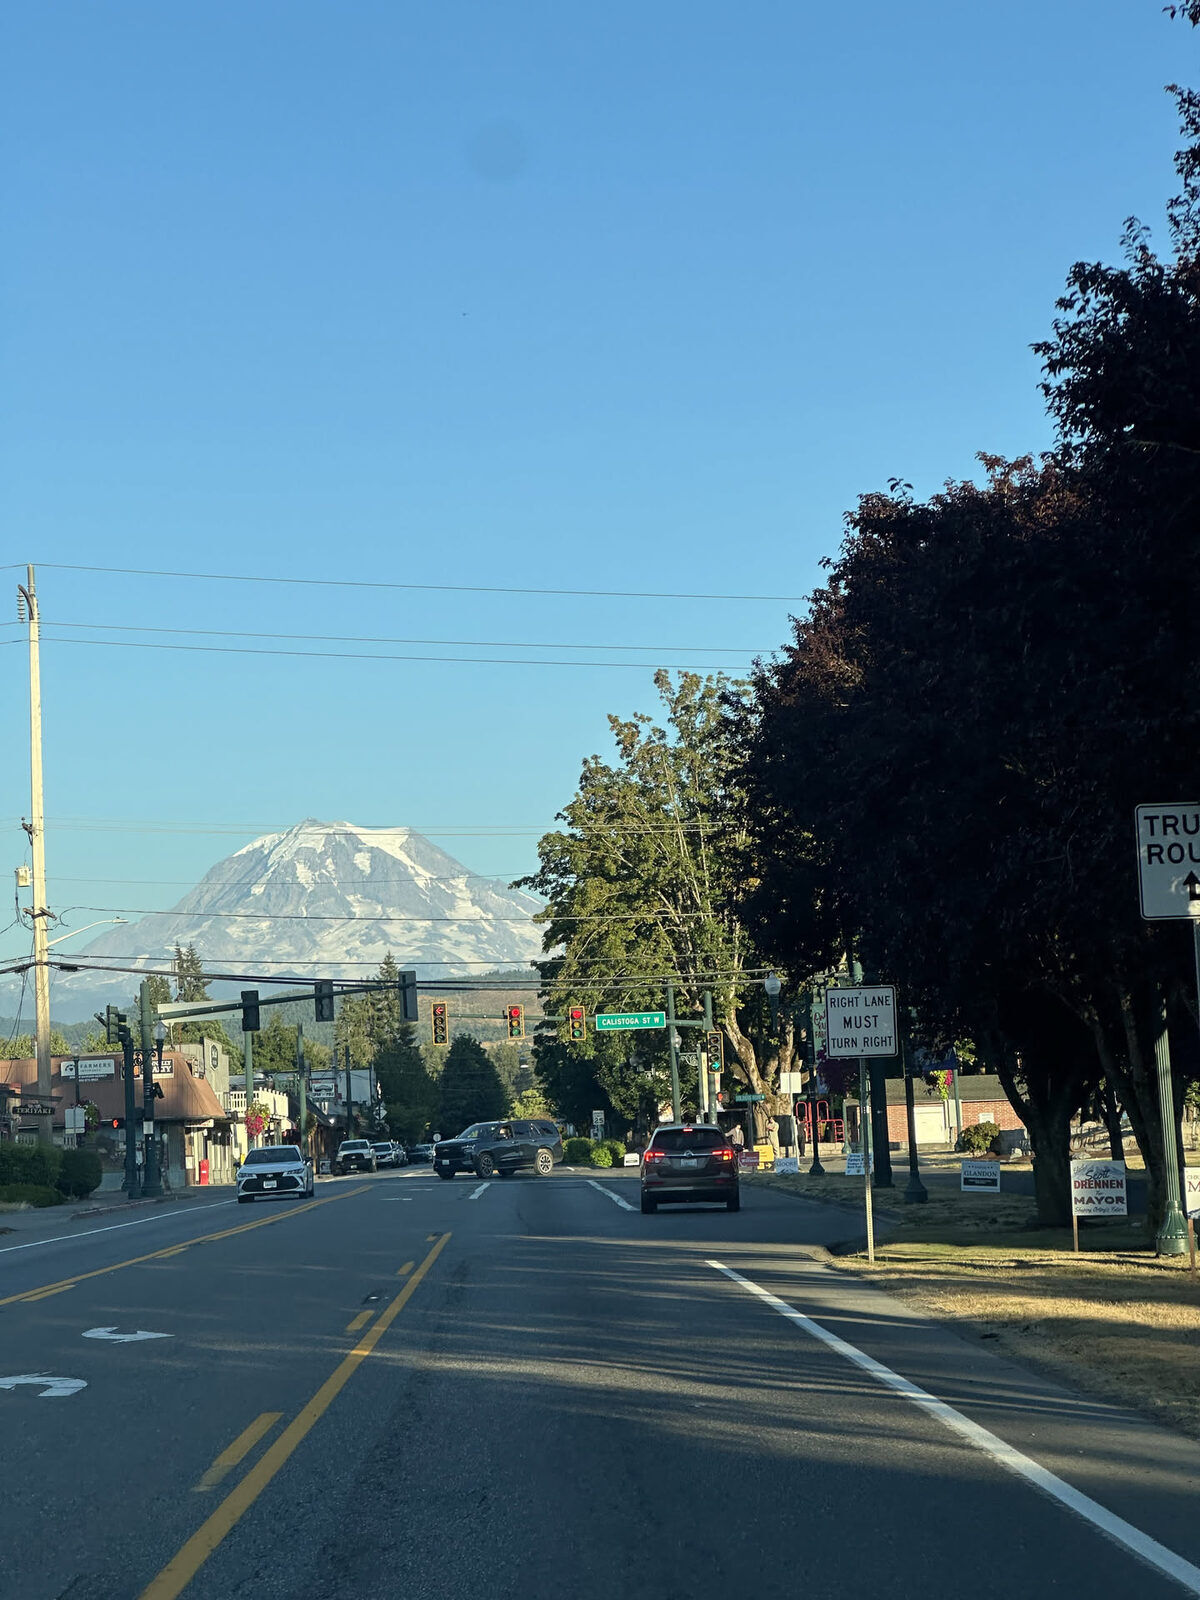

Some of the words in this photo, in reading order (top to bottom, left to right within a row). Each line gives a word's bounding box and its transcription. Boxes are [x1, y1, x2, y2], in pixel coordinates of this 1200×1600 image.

[830, 997, 860, 1008] RIGHT
[865, 996, 891, 1007] LANE
[602, 1018, 639, 1026] CALISTOGA
[654, 1016, 660, 1024] W
[843, 1015, 878, 1029] MUST
[831, 1037, 857, 1049] TURN
[863, 1036, 893, 1047] RIGHT
[964, 1170, 997, 1178] GLANDON
[1085, 1167, 1111, 1180] Scott
[1074, 1180, 1124, 1190] DRENNEN
[1074, 1196, 1126, 1205] MAYOR
